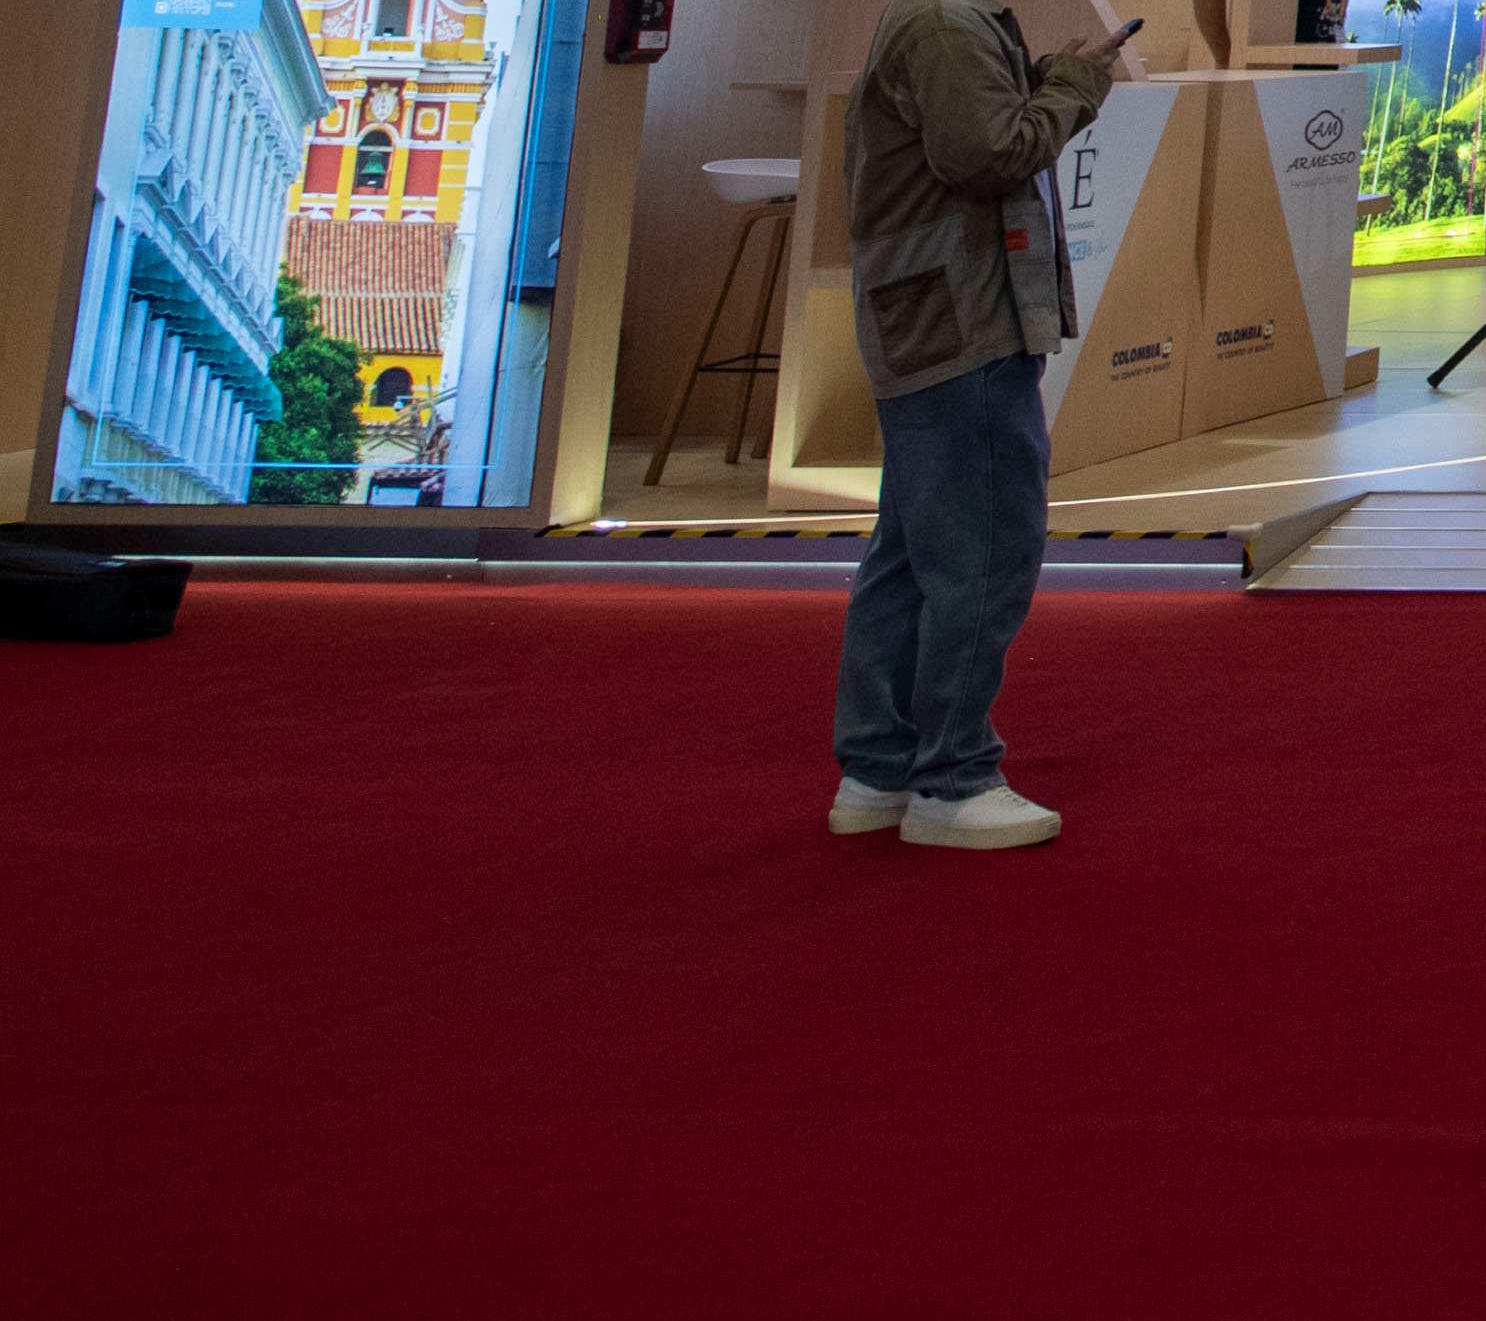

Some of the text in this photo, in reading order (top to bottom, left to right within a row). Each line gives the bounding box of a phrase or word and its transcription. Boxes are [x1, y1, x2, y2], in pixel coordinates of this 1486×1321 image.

[1285, 151, 1356, 173] ARMESSO
[1216, 324, 1262, 346] COLOMBIA
[1112, 342, 1161, 367] COLOMBIA
